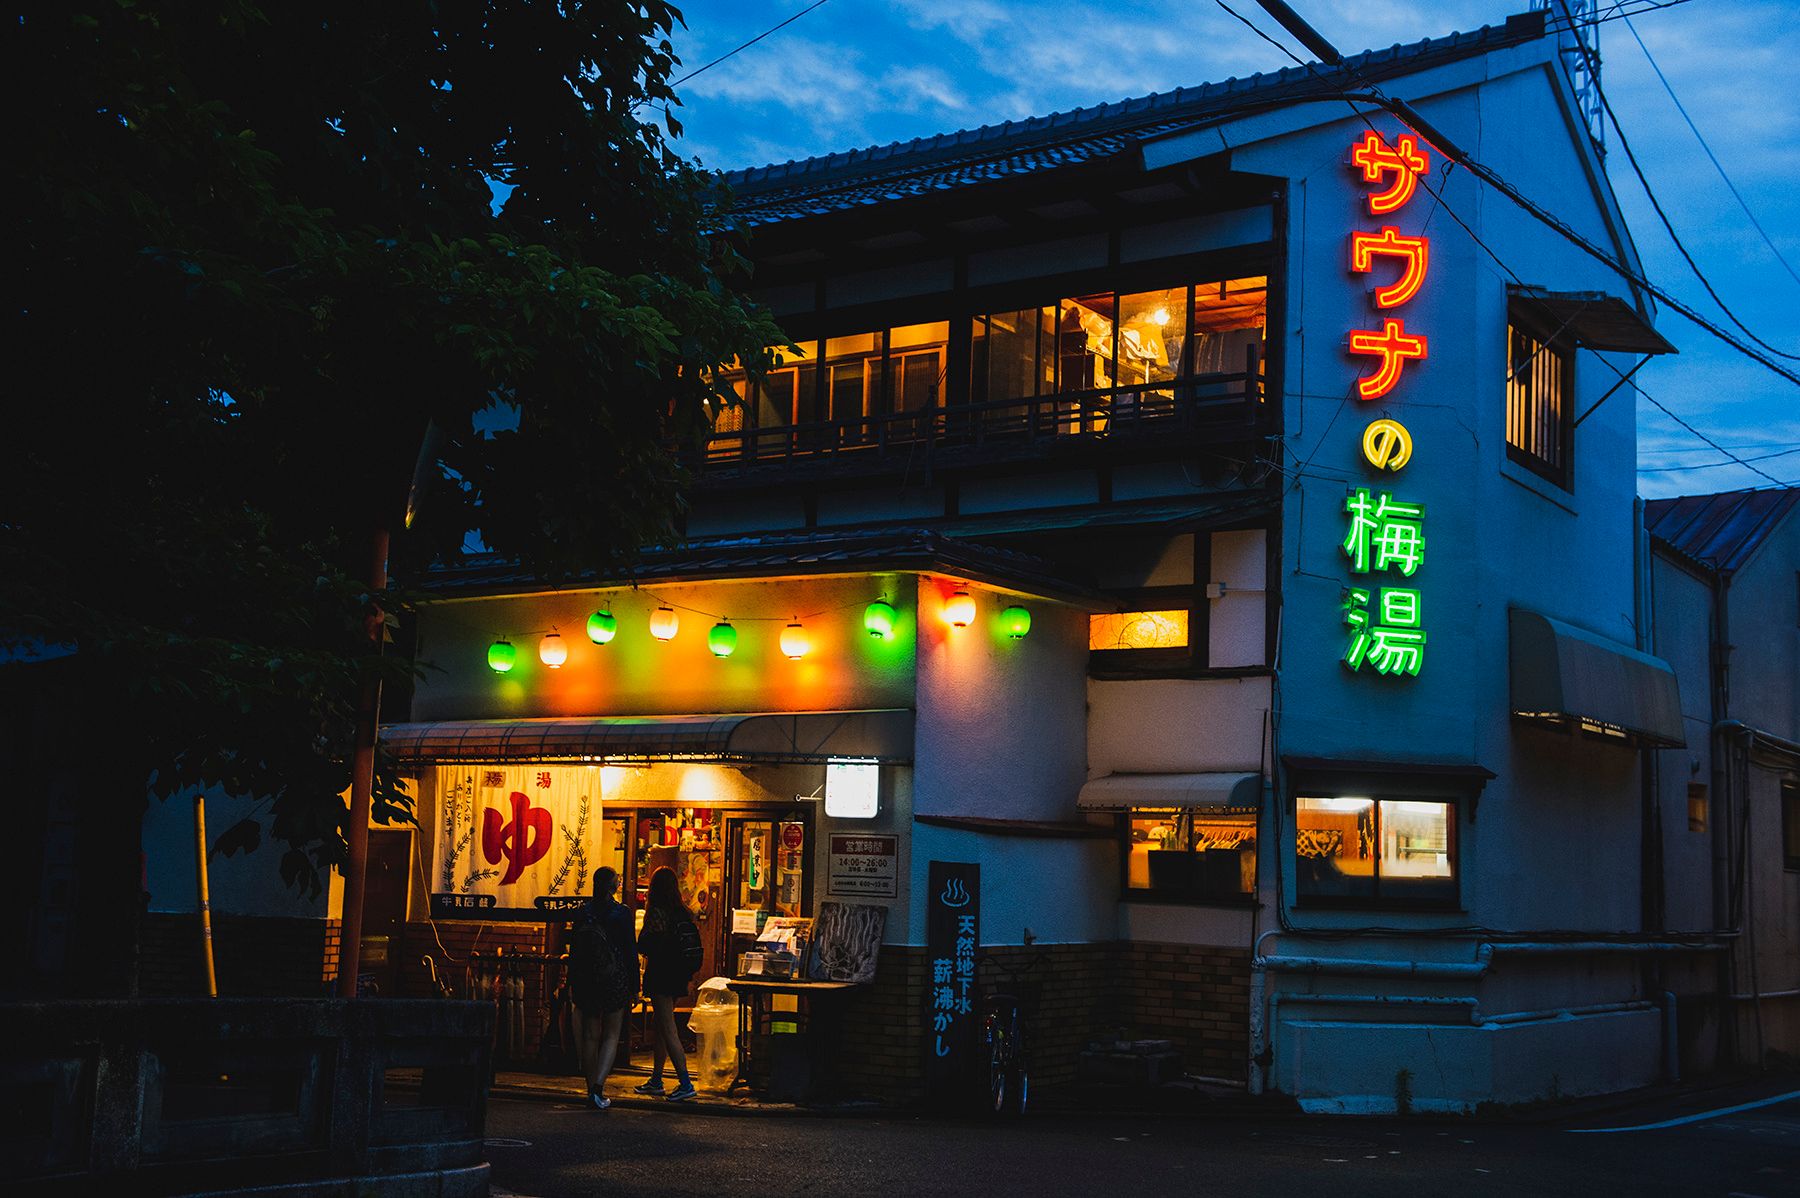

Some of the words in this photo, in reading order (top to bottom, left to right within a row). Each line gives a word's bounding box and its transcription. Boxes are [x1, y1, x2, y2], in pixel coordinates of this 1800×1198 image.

[1340, 130, 1429, 678] サウナの梅湯
[482, 791, 553, 886] ゆ
[845, 840, 883, 853] 営業時間
[933, 958, 954, 1058] 薪沸かし
[955, 914, 976, 1016] 天然地下水
